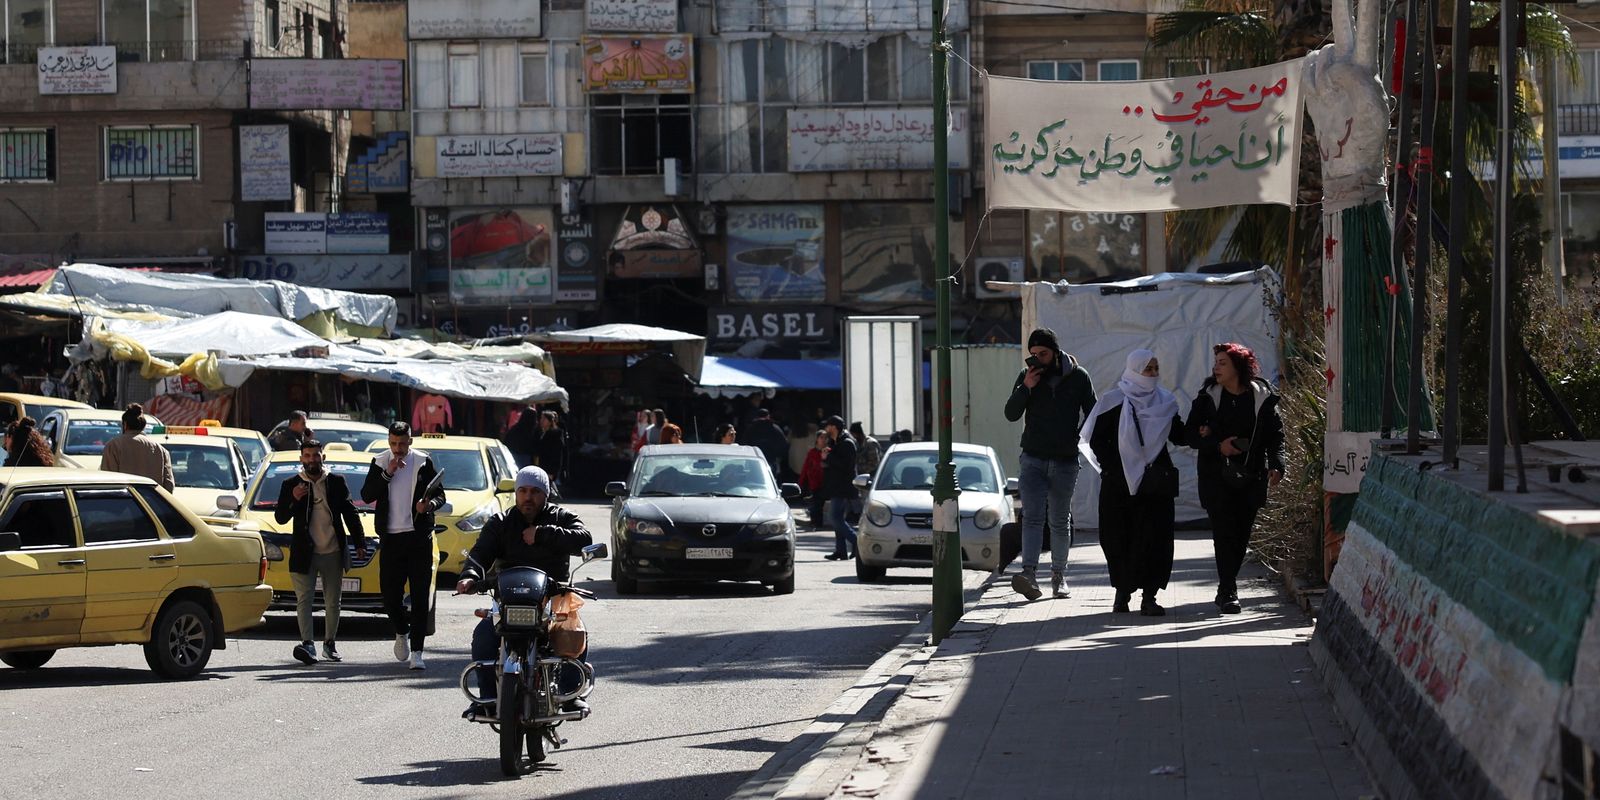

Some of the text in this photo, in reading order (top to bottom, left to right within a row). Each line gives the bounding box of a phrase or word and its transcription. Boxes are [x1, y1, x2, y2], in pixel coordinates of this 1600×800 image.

[1227, 77, 1287, 112] من
[791, 113, 828, 137] سعيد
[883, 113, 921, 135] عادل
[440, 138, 557, 161] حسام كمال الفقيه
[287, 222, 305, 231] سهيل
[559, 223, 593, 241] السيد
[243, 257, 295, 281] Dio
[716, 313, 824, 338] BASEL
